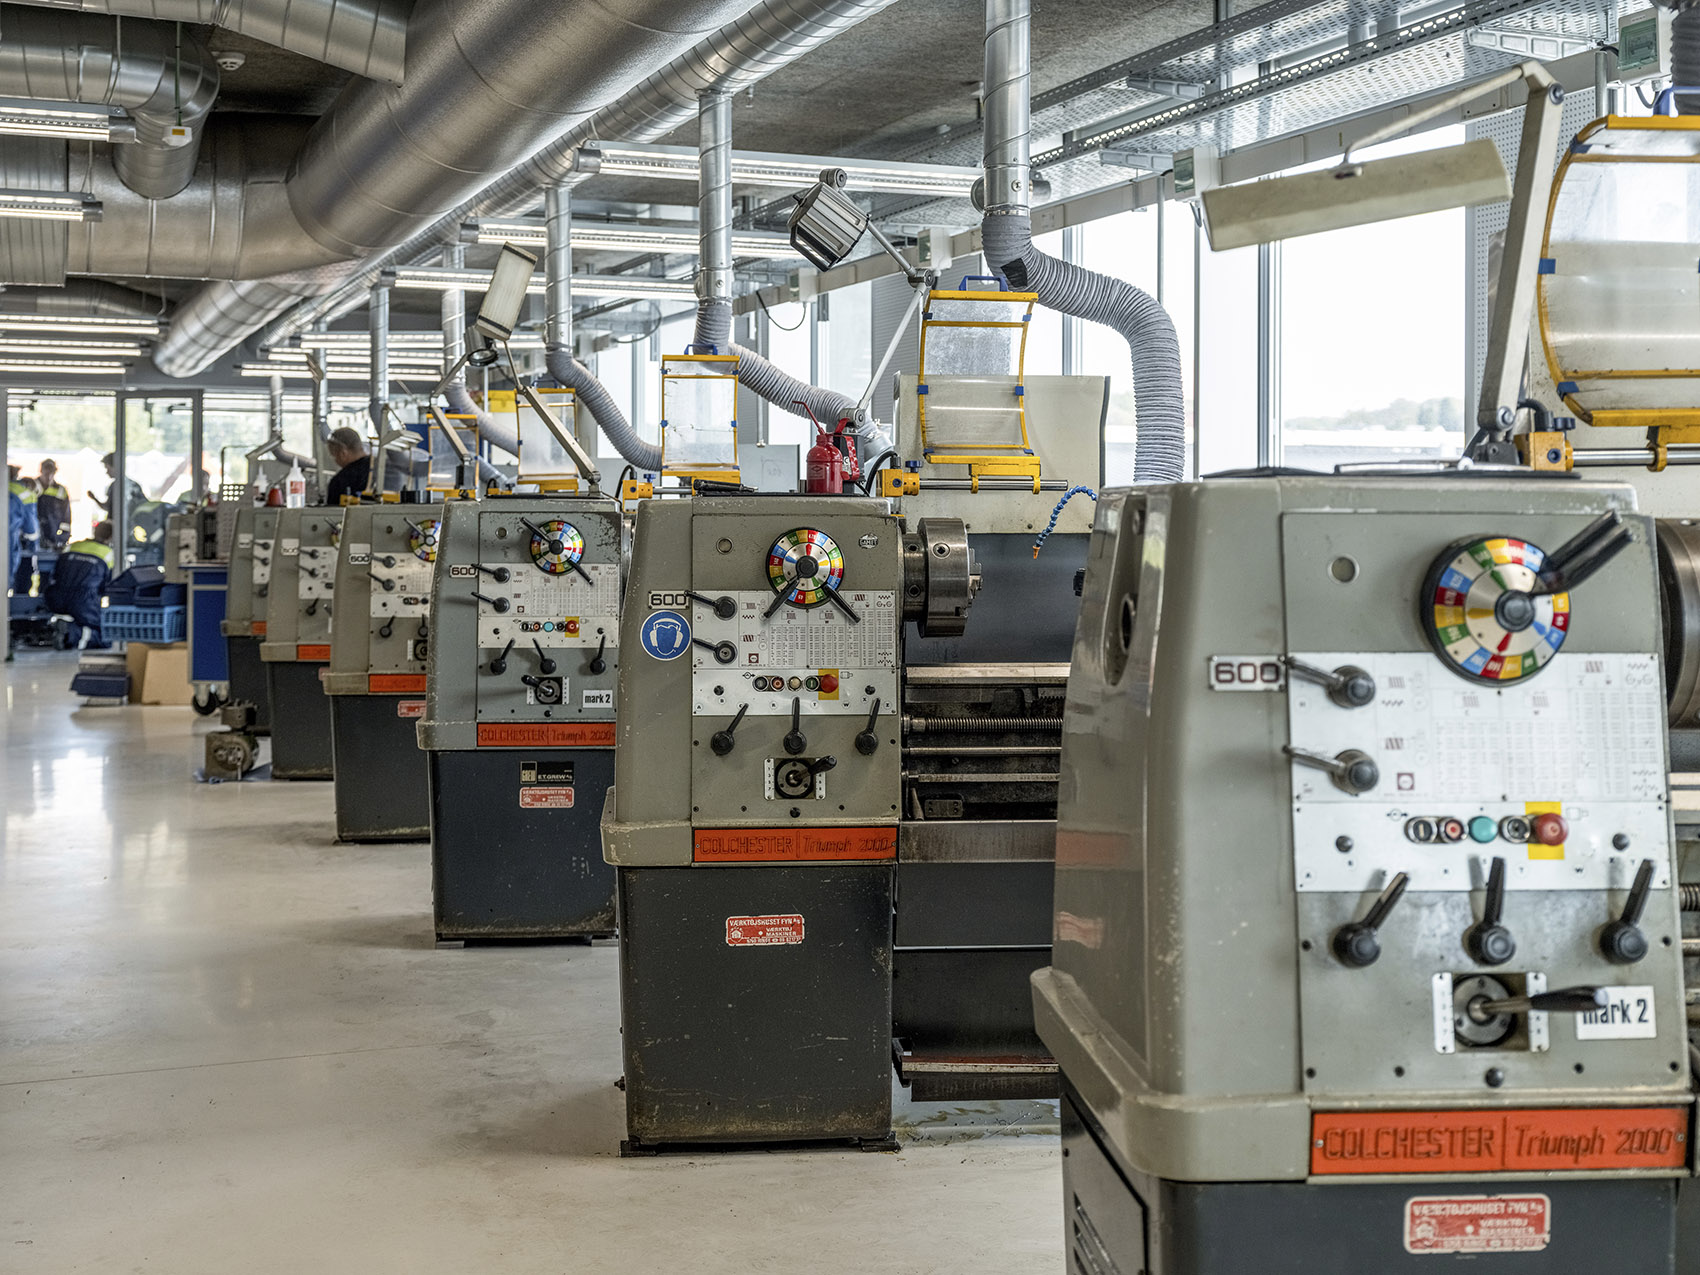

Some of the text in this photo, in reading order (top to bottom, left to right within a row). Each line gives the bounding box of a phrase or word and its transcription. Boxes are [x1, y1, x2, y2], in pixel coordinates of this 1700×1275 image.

[452, 567, 476, 575] 600
[651, 594, 686, 605] 600
[1215, 663, 1280, 683] 600
[585, 694, 610, 703] mark 2
[480, 728, 545, 742] COLCHESTER
[552, 729, 586, 744] Triumph
[700, 835, 889, 857] COLCHESTER Triumph 2000
[1637, 998, 1650, 1023] 2
[1323, 1125, 1674, 1166] COLCHESTER Triumph 2000
